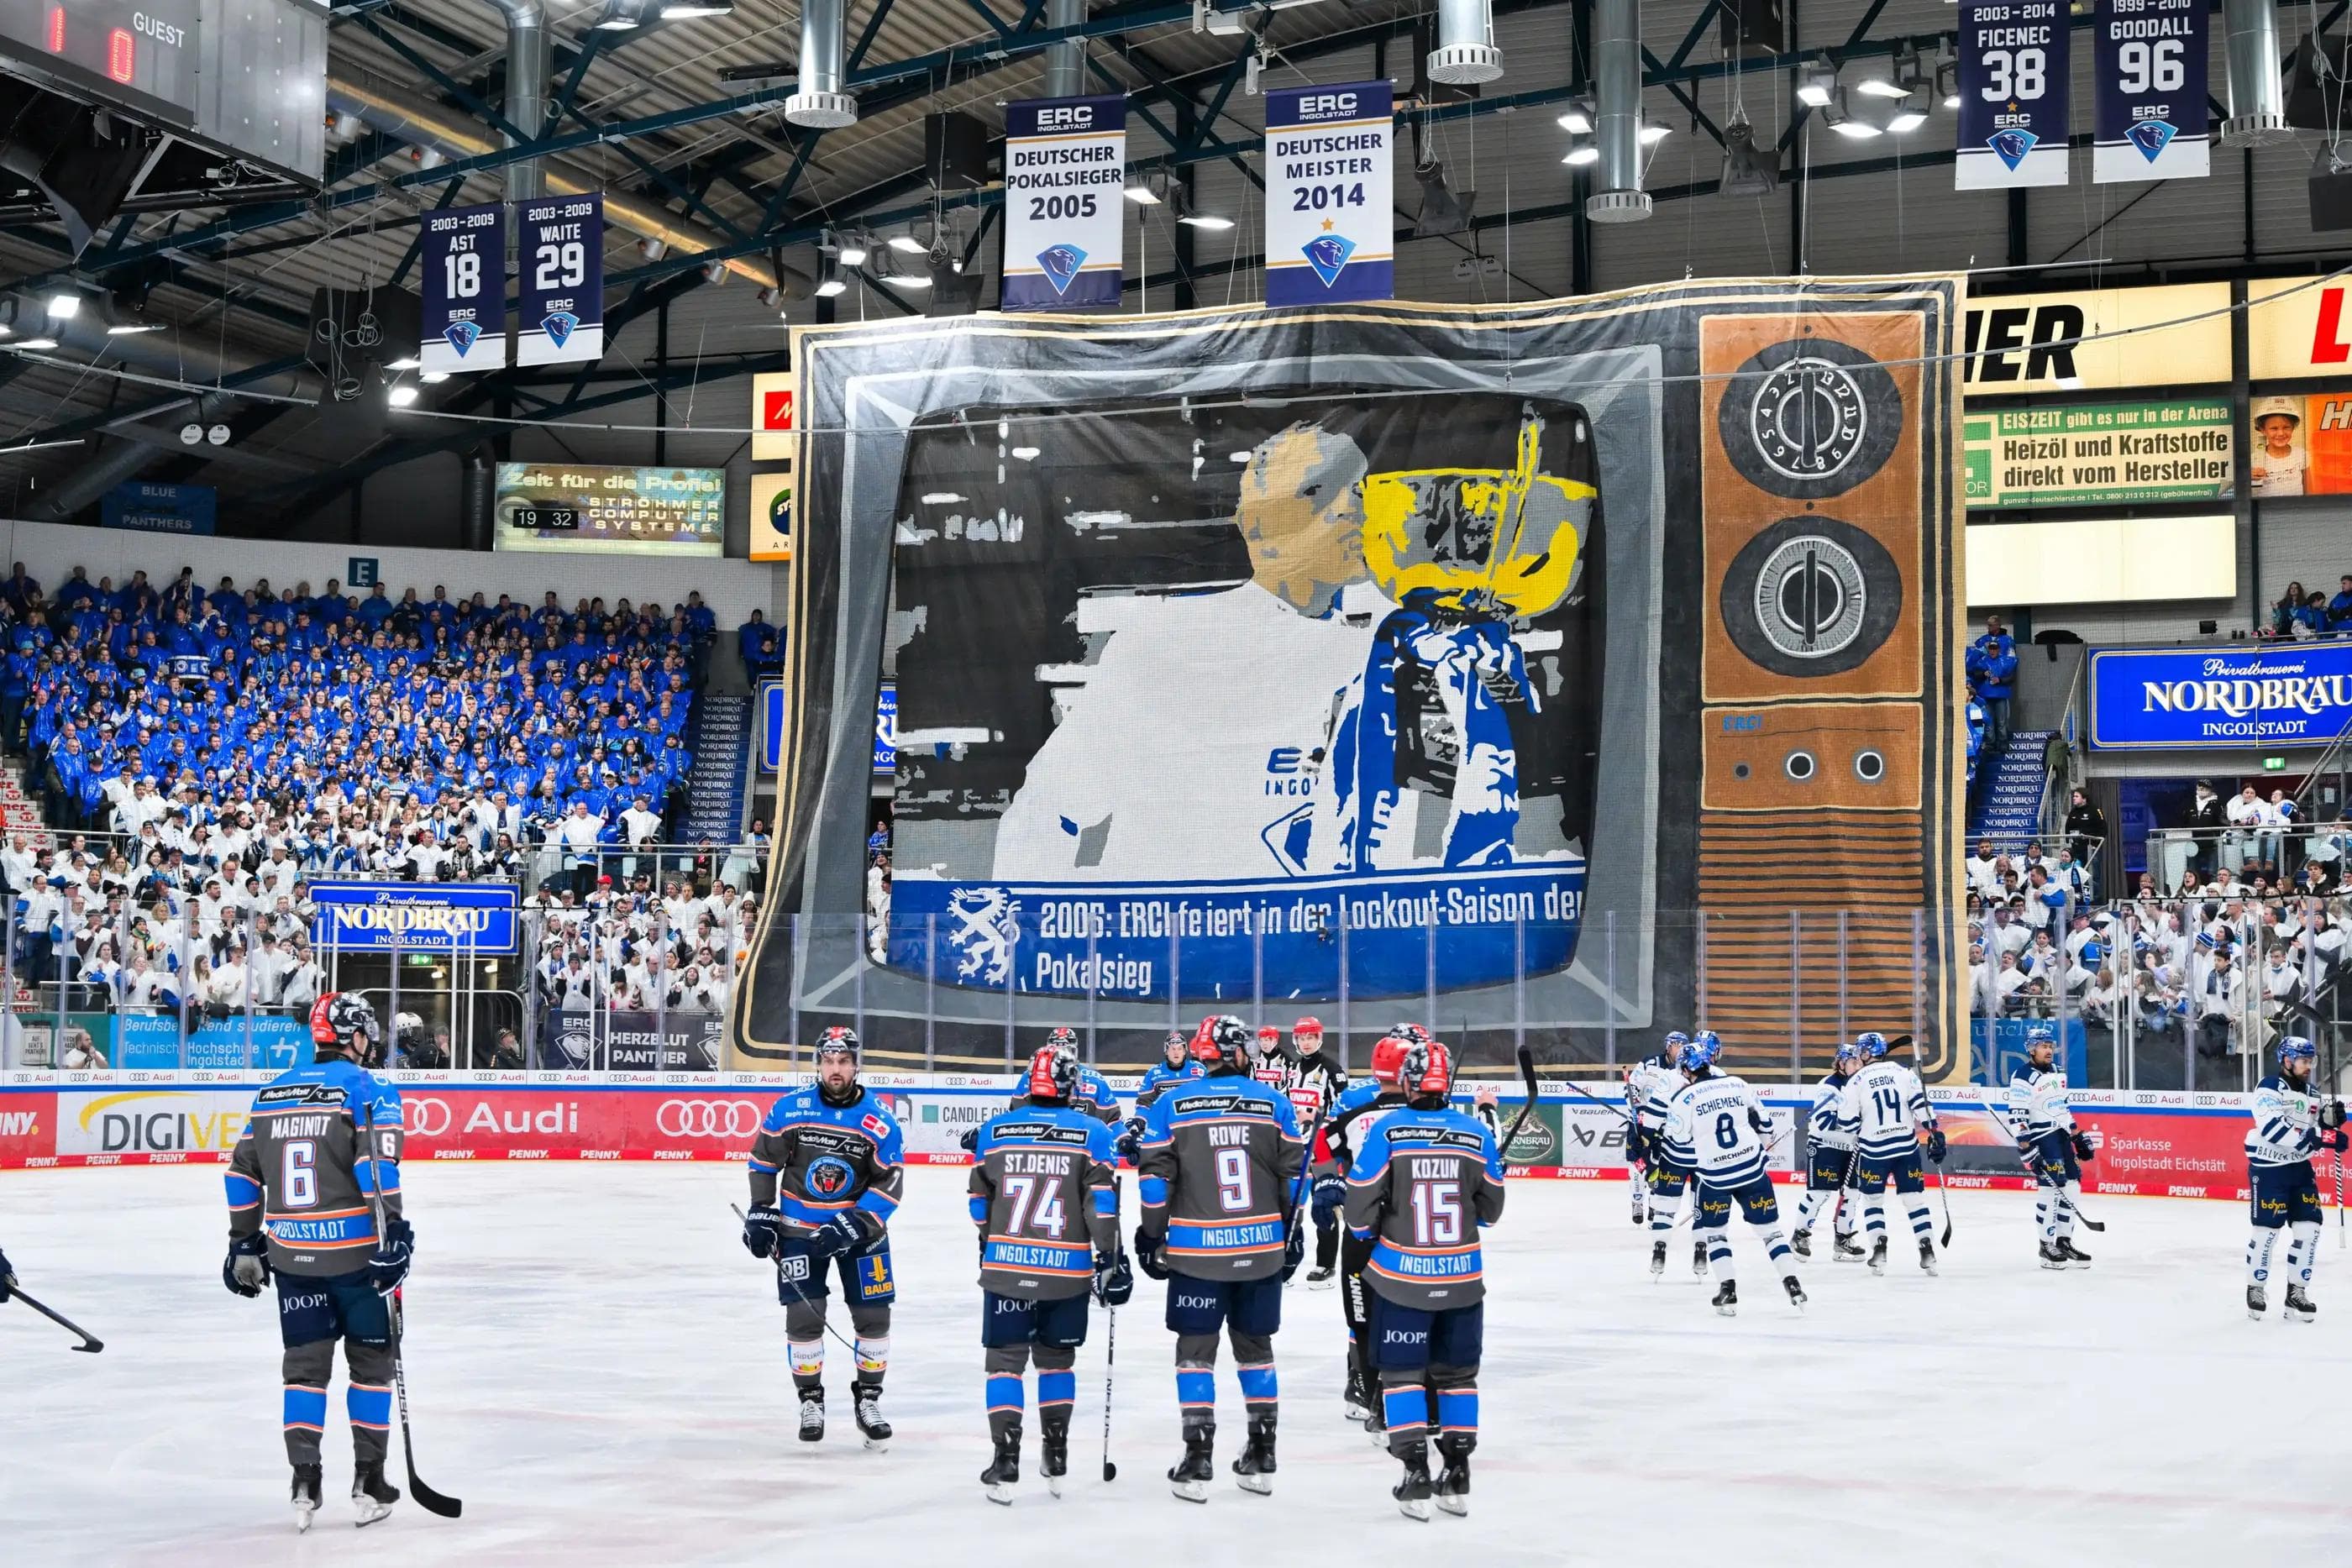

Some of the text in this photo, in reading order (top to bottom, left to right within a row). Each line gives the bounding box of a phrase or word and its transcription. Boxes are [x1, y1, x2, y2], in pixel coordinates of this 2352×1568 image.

[133, 12, 186, 48] GUEST
[1977, 25, 2050, 48] FICENEC
[2110, 17, 2193, 40] GOODALL
[2118, 39, 2184, 94] 96
[1981, 48, 2045, 102] 38
[1299, 92, 1357, 113] ERC
[1037, 106, 1093, 124] ERC
[1299, 111, 1357, 121] INGOLSTADT
[1994, 113, 2031, 125] ERC
[2132, 105, 2171, 117] ERC
[1037, 123, 1093, 132] INGOLSTADT
[1275, 134, 1383, 157] DEUTSCHER
[1014, 146, 1115, 167] DEUTSCHER
[1286, 157, 1373, 179] MEISTER
[1007, 168, 1122, 190] POKALSIEGER
[1292, 182, 1366, 212] 2014
[1029, 193, 1097, 221] 2005
[539, 223, 581, 243] WAITE
[449, 234, 476, 252] AST
[536, 242, 585, 291] 29
[445, 253, 480, 299] 18
[546, 298, 574, 309] ERC
[449, 308, 476, 319] ERC
[2003, 406, 2229, 430] EISZEIT gibt es nur in der Arena
[2004, 431, 2229, 461] Heizöl und Kraftstoffe
[509, 472, 554, 487] Zeit
[561, 475, 596, 489] für
[603, 475, 638, 489] die
[2004, 459, 2229, 488] direkt vom Hersteller
[141, 485, 177, 497] BLUE
[2003, 494, 2087, 506] gunvor-deutschland.de
[2092, 492, 2106, 501] Tel.
[589, 496, 719, 510] STRÖHMER
[123, 515, 193, 530] PANTHERS
[517, 511, 572, 526] 19 32
[589, 508, 718, 522] COMPUTER
[595, 521, 711, 532] SYSTEME
[356, 562, 370, 584] E
[2202, 658, 2307, 677] Privatbrauerei
[2142, 674, 2352, 718] NORDBRÄU
[1723, 715, 1761, 731] ERCI
[2202, 720, 2307, 736] INGOLSTADT
[375, 892, 449, 905] Privatbrauerei
[1178, 900, 1252, 937] feiert
[1261, 899, 1281, 934] in
[1289, 897, 1331, 933] der
[1339, 886, 1535, 931] Lockout-Saison
[1036, 952, 1152, 996] Pokalsieg
[238, 1019, 301, 1033] sudieren
[610, 1031, 690, 1046] HERZBLUT
[125, 1041, 260, 1055] Technisch Hochschue
[187, 1055, 246, 1069] Ingolstad
[92, 1073, 113, 1082] Audi
[153, 1072, 175, 1082] Audi
[217, 1072, 239, 1081] Audi
[424, 1072, 448, 1081] Audi
[501, 1072, 525, 1082] Audi
[565, 1072, 590, 1082] Audi
[631, 1073, 655, 1083] Audi
[692, 1074, 716, 1083] Audi
[760, 1075, 784, 1083] Audi
[893, 1077, 916, 1085] Audi
[1696, 1095, 1745, 1116] SCHIEMENZ
[2090, 1093, 2114, 1102] Audi
[2160, 1095, 2184, 1104] Audi
[2219, 1097, 2242, 1105] Audi
[942, 1107, 988, 1123] CANDLE
[1872, 1088, 1901, 1126] 14
[463, 1102, 579, 1133] Audi
[270, 1115, 331, 1140] MAGINOT
[1208, 1125, 1250, 1146] ROWE
[1715, 1113, 1739, 1149] 8
[381, 1132, 396, 1157] 6
[2110, 1136, 2171, 1153] Sparkasse
[25, 1156, 60, 1167] PENNY.
[86, 1155, 121, 1166] PENNY.
[149, 1153, 187, 1163] PENNY.
[433, 1149, 476, 1160] PENNY.
[507, 1149, 550, 1160] PENNY.
[580, 1149, 623, 1160] PENNY.
[653, 1150, 695, 1161] PENNY.
[928, 1154, 966, 1164] PENNY.
[1713, 1146, 1755, 1163] KIRCHHOFF
[1004, 1153, 1070, 1176] ST.DENIS
[1411, 1158, 1460, 1179] KOZUN
[2110, 1156, 2227, 1172] Ingolstadt Eichstätt
[281, 1138, 319, 1209] 6
[1215, 1146, 1253, 1213] 9
[1557, 1168, 1601, 1178] PENNY.
[1946, 1177, 1992, 1188] PENNY.
[2097, 1182, 2139, 1194] PENNY.
[2168, 1185, 2208, 1198] PENNY.
[1003, 1175, 1066, 1240] 74
[1411, 1181, 1462, 1246] 15
[270, 1219, 346, 1240] INGOLSTADT
[1201, 1225, 1273, 1247] INGOLSTADT
[995, 1245, 1070, 1267] INGOLSTADT
[1399, 1255, 1472, 1275] INGOLSTADT
[864, 1282, 893, 1296] BAUER
[284, 1293, 328, 1311] JOOP!
[1176, 1294, 1216, 1309] JOOP!
[1349, 1272, 1366, 1323] PENNY.
[995, 1299, 1037, 1314] JOOP!
[1383, 1329, 1427, 1345] JOOP!
